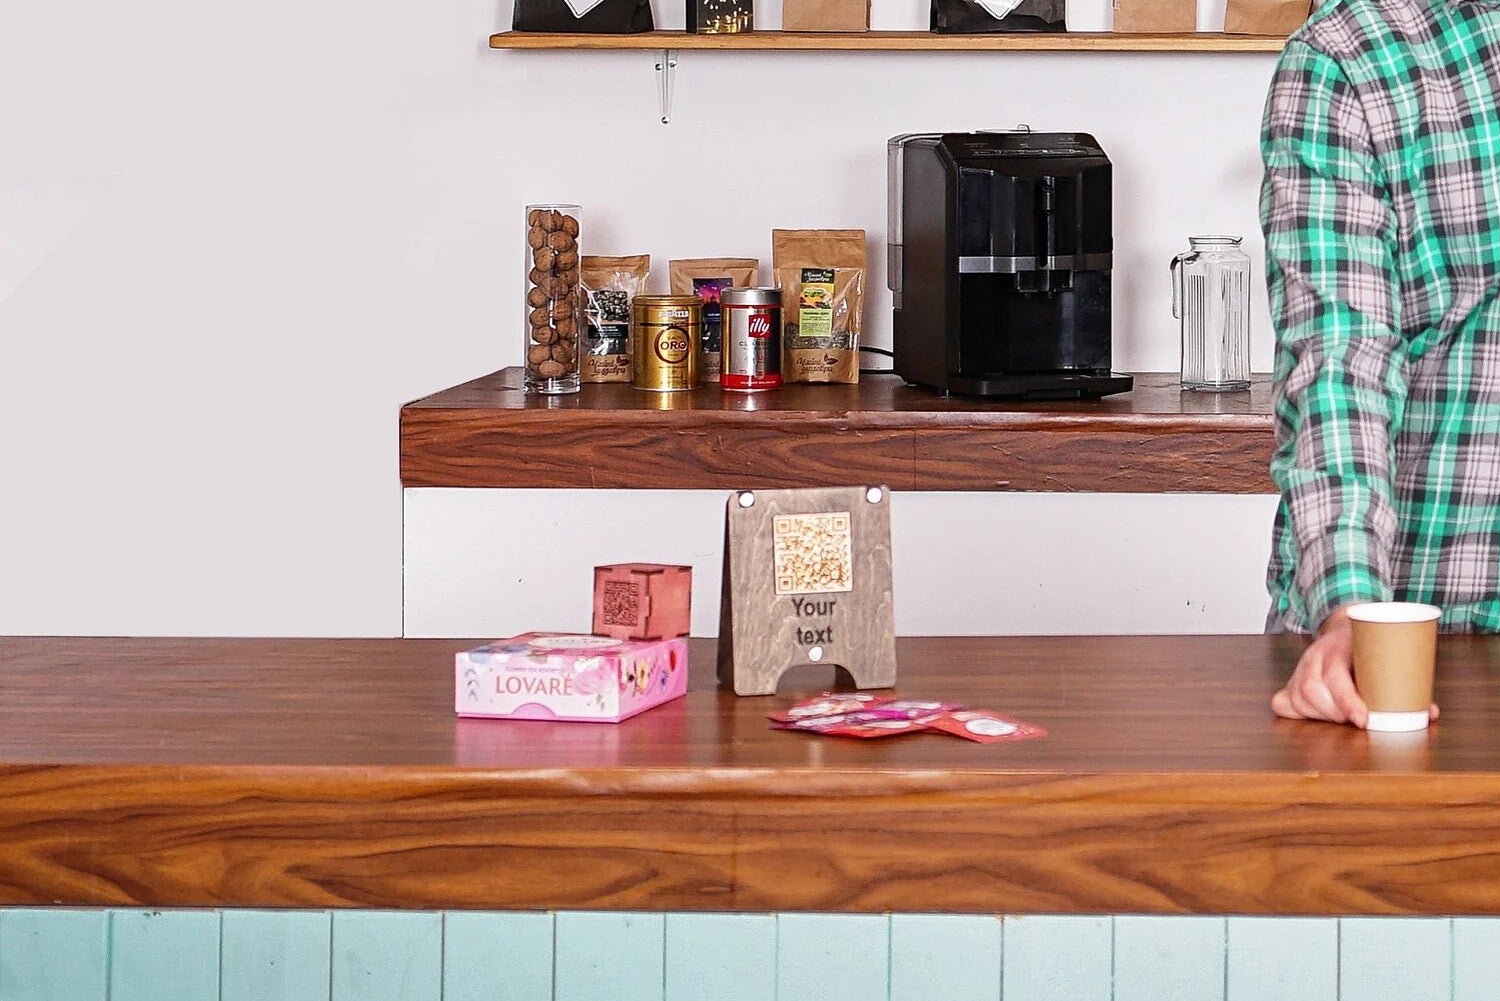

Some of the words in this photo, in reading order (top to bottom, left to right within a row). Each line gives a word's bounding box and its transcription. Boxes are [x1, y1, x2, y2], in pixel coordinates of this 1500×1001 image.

[749, 318, 770, 336] illy
[660, 341, 687, 350] ORO
[792, 598, 836, 617] Your
[796, 626, 833, 645] text
[496, 673, 573, 696] LOVARÉ
